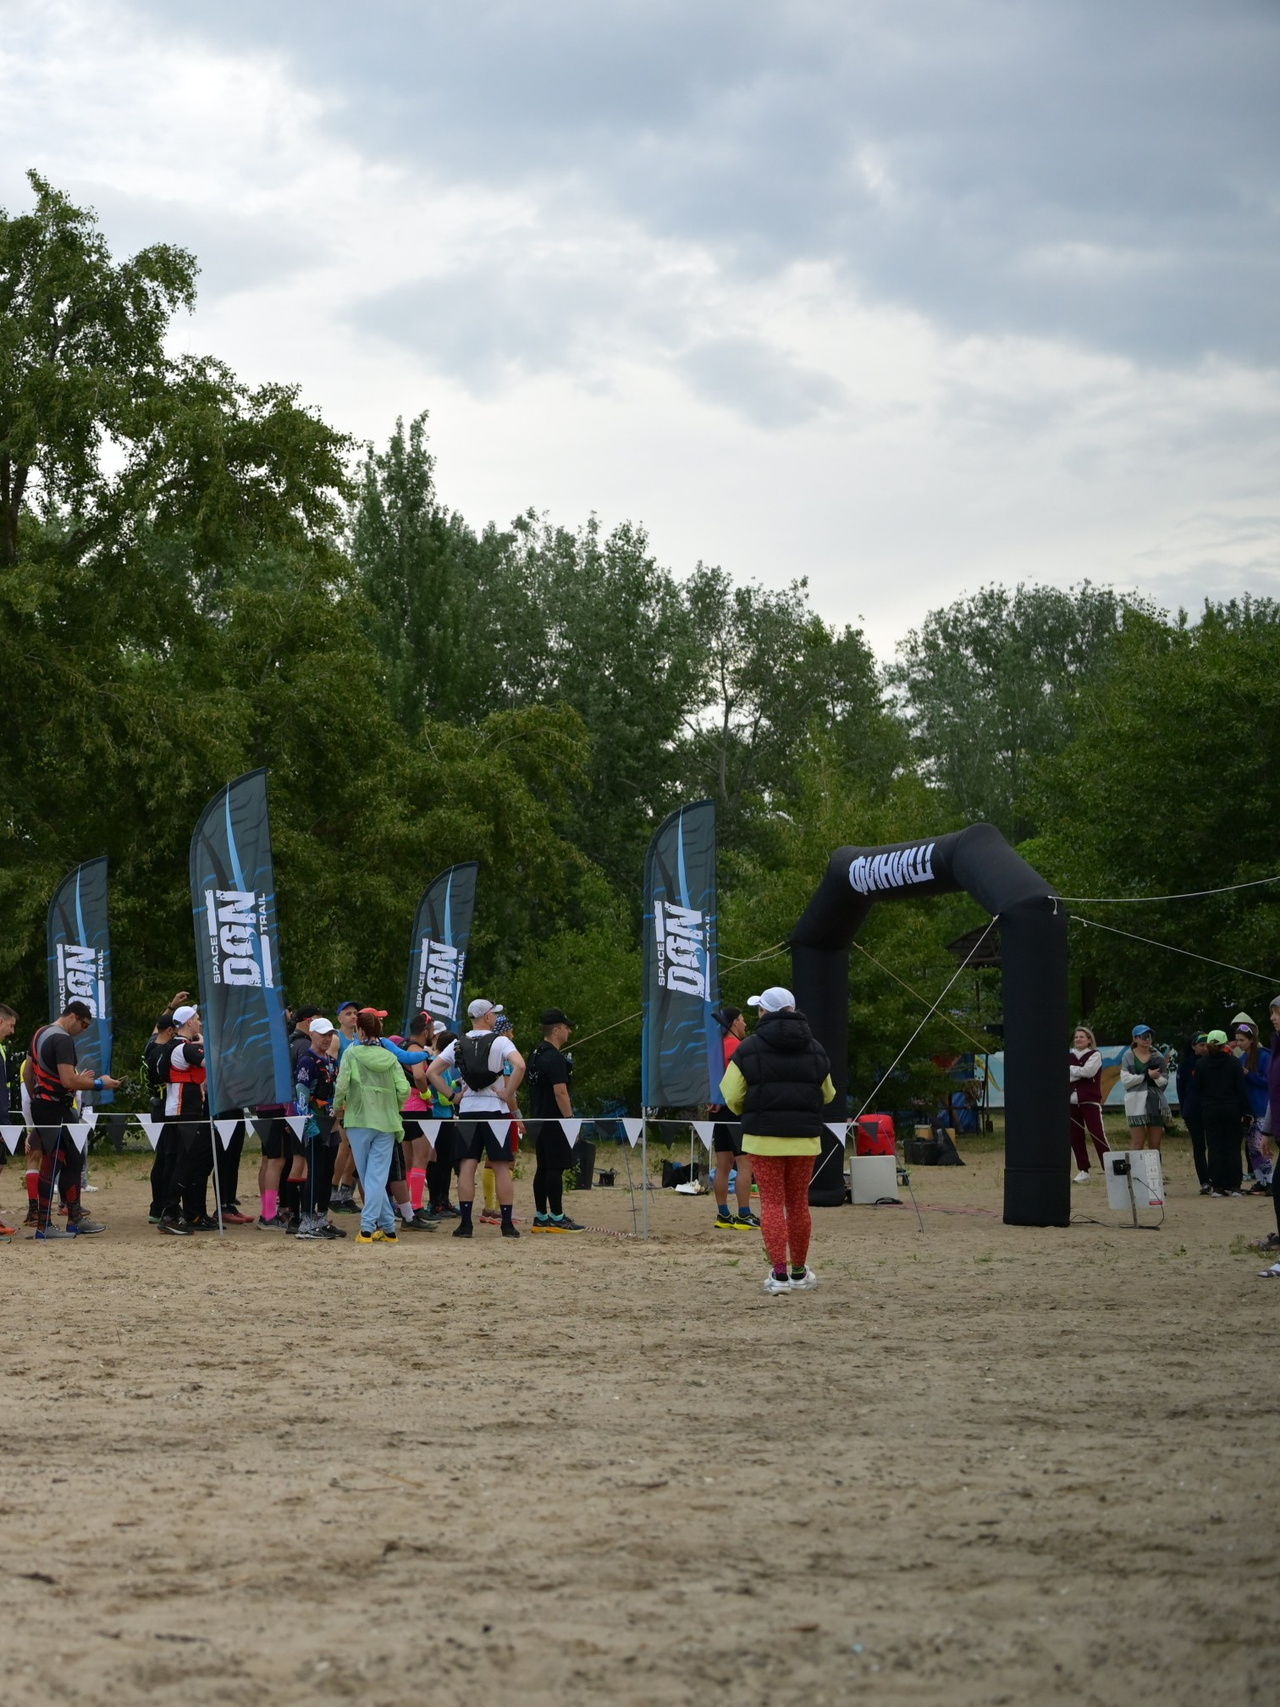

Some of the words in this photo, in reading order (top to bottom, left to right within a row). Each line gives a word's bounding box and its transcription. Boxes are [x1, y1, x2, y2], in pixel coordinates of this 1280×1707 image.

[849, 843, 935, 895] ФИНИШ
[216, 890, 262, 987] DON
[258, 893, 268, 933] TRAIL
[211, 936, 220, 983] SPACE
[664, 901, 704, 998] DON
[416, 973, 425, 1007] SPACE
[424, 940, 458, 1019] DON
